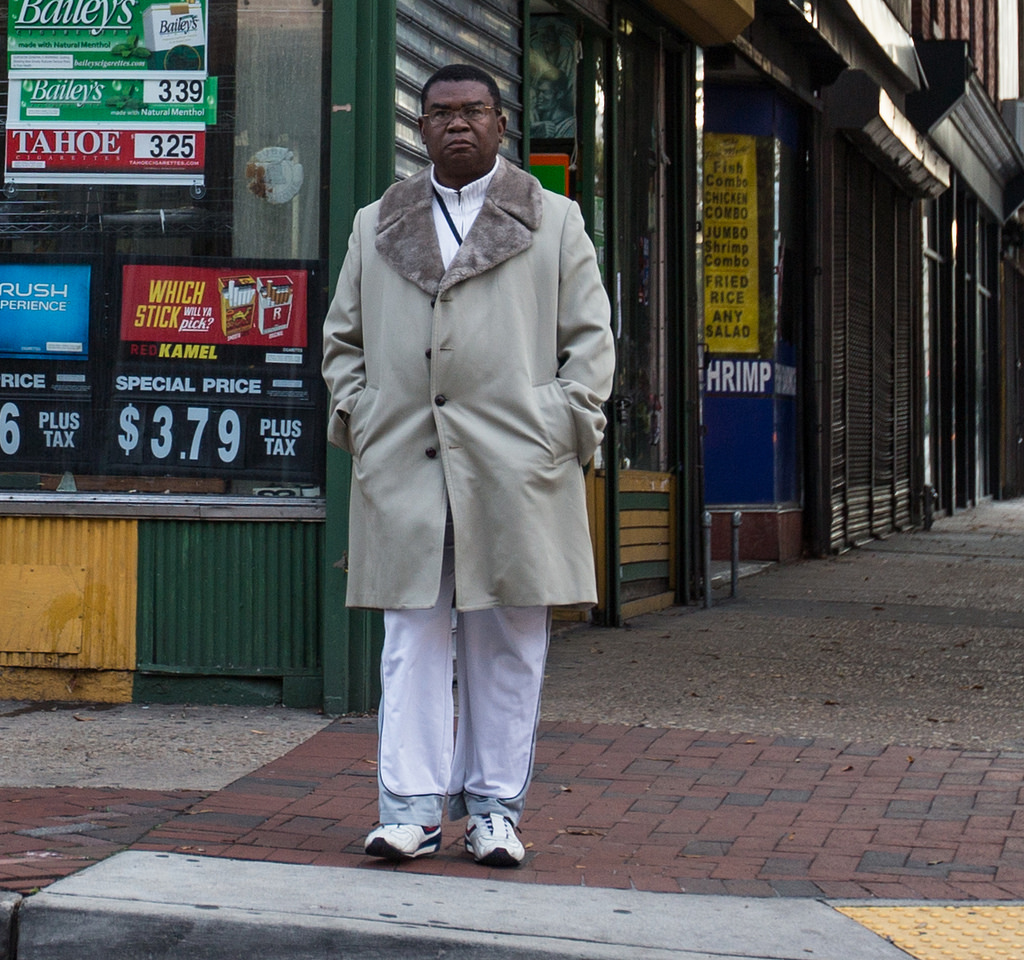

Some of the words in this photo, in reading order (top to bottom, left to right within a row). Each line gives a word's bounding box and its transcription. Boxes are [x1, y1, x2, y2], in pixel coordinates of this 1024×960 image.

[159, 15, 199, 34] Bailey's
[74, 59, 146, 68] baileyscigarettes.com
[30, 79, 105, 107] Bailey's
[158, 79, 203, 103] 3.39
[141, 108, 170, 116] Natural
[170, 108, 205, 117] Menthol
[12, 131, 121, 154] TAHOE
[149, 134, 194, 158] 3.25
[706, 175, 748, 188] Combo
[706, 192, 748, 205] CHICKEN
[705, 207, 748, 220] COMBO
[705, 226, 748, 239] JUMBO
[705, 241, 749, 256] Shrimp
[705, 254, 749, 267] Combo
[706, 275, 749, 289] FRIED
[148, 280, 206, 305] WHICH
[710, 291, 745, 304] RICE
[134, 305, 182, 328] STICK
[183, 306, 201, 317] WILL
[202, 306, 213, 317] YA
[712, 309, 743, 323] ANY
[179, 317, 215, 331] pick?
[706, 325, 751, 338] SALAD
[130, 343, 157, 356] RED
[158, 343, 218, 360] KAMEL
[115, 376, 196, 392] SPECIAL
[203, 378, 262, 394] PRICE
[38, 411, 80, 429] PLUS
[260, 418, 302, 438] PLUS
[43, 430, 75, 448] TAX
[264, 438, 296, 456] TAX
